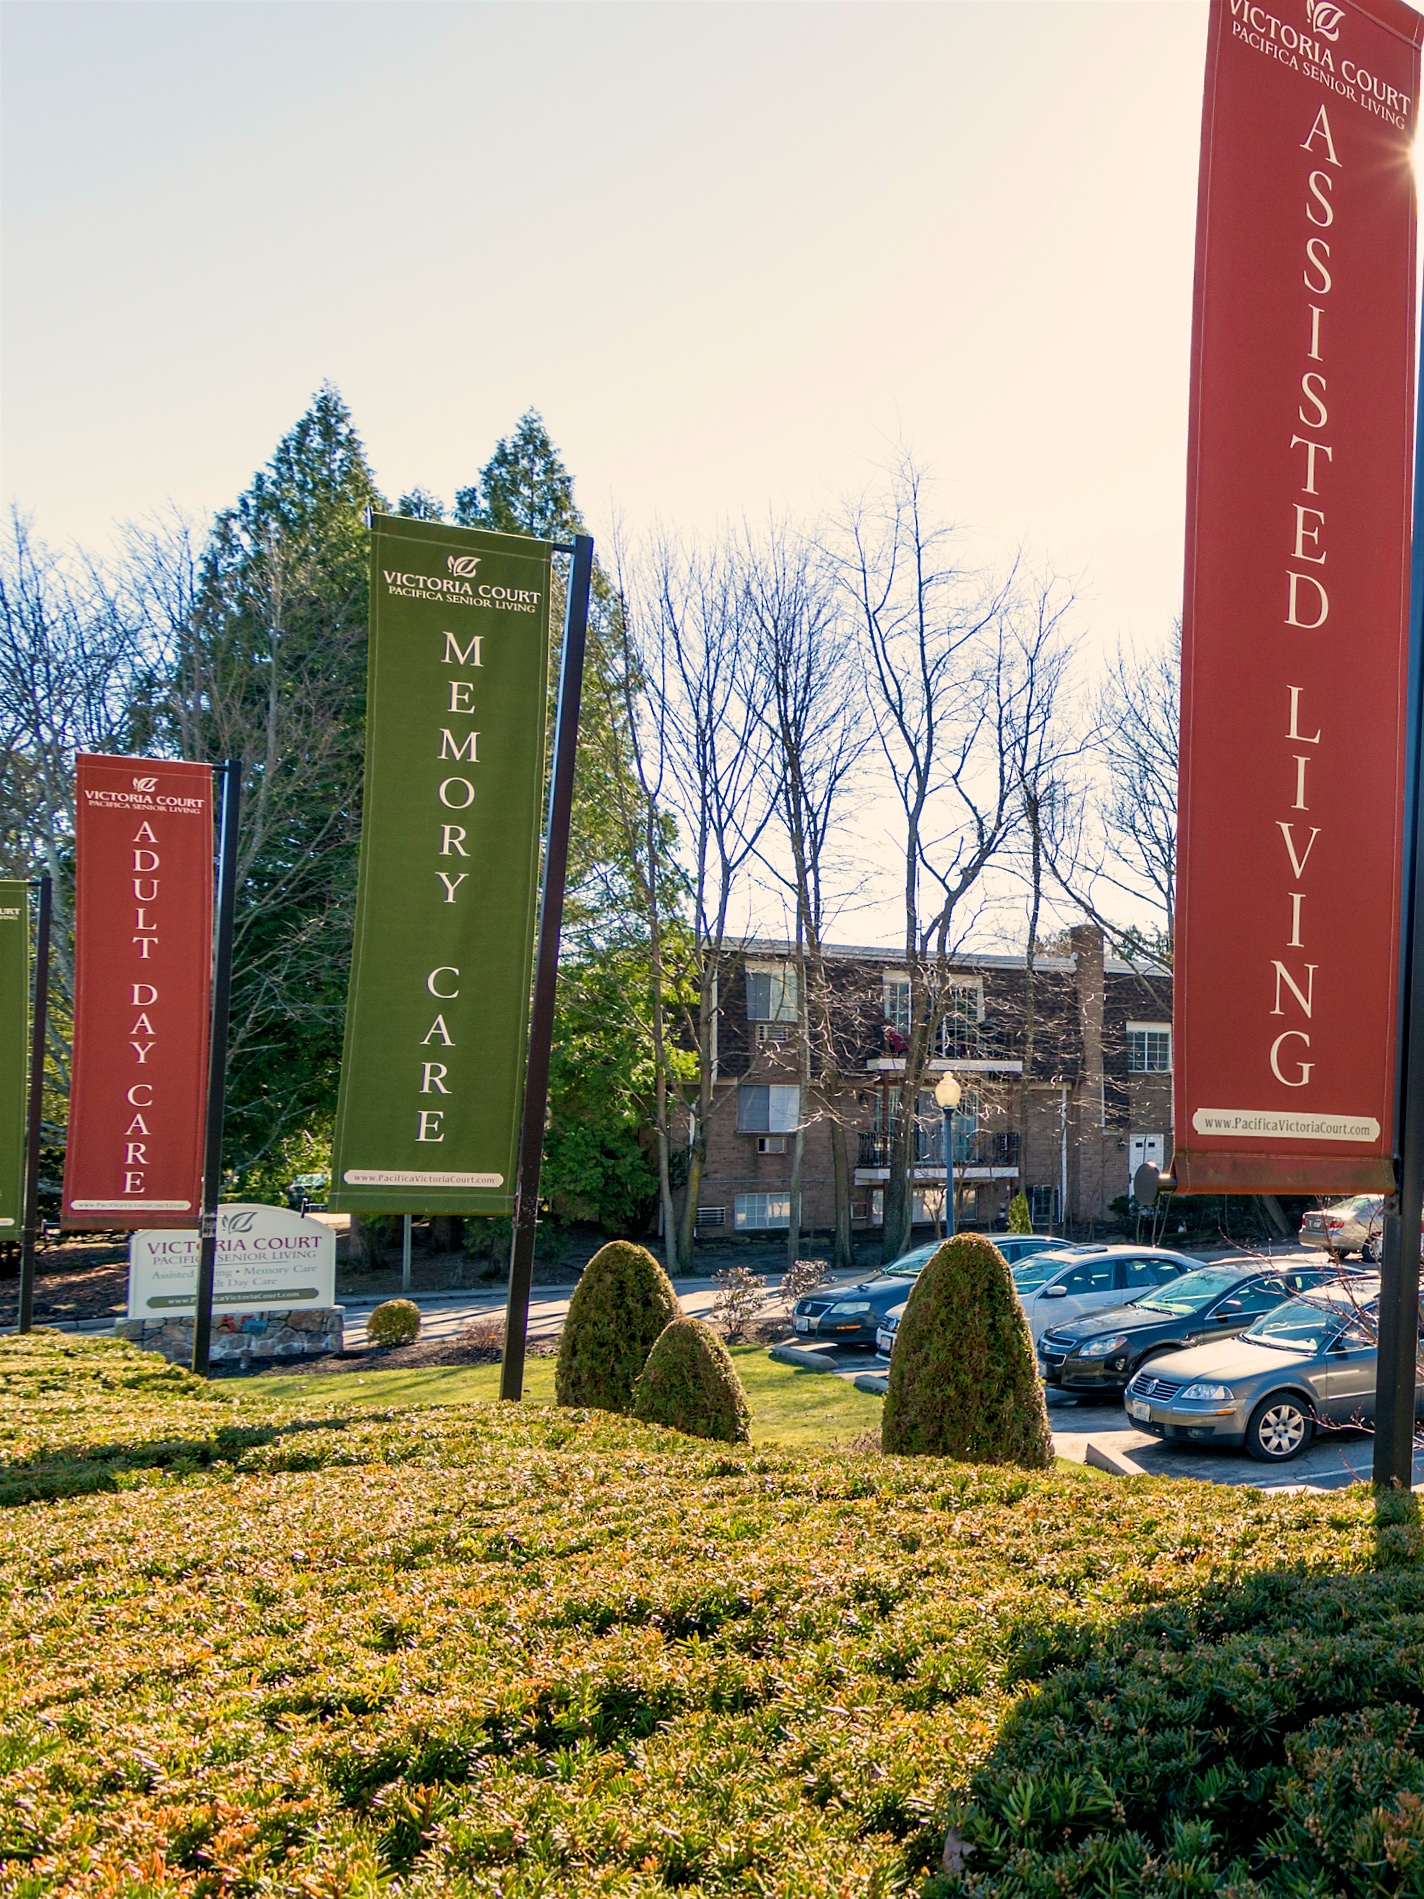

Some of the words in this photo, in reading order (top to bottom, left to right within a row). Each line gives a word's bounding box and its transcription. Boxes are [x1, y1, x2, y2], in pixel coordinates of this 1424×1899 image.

[1230, 0, 1335, 73] VICTORIA
[1341, 60, 1411, 116] COURT
[1232, 20, 1299, 71] PACIFICA
[1302, 61, 1357, 102] SENIOR
[1360, 94, 1405, 130] LIVING
[1284, 103, 1343, 629] ASSISTED
[383, 569, 473, 595] VICTORIA
[478, 585, 541, 604] COURT
[388, 585, 443, 602] PACIFICA
[446, 594, 492, 608] SENIOR
[496, 600, 536, 613] LIVING
[435, 631, 485, 903] MEMORY
[84, 789, 153, 804] VICTORIA
[156, 796, 205, 808] COURT
[88, 799, 131, 809] PACIFICA
[132, 803, 167, 812] SENIOR
[169, 806, 200, 815] LIVING
[132, 820, 160, 959] ADULT
[1269, 684, 1321, 1087] LIVING
[0, 907, 21, 915] URT
[129, 983, 158, 1064] DAY
[414, 966, 460, 1143] CARE
[122, 1083, 153, 1194] CARE
[1204, 1117, 1370, 1136] www.PacificaVictoriaCourt.com
[354, 1173, 495, 1184] www.PacificaVictoriaCourt.com
[147, 1239, 246, 1255] VICTRIA
[253, 1236, 322, 1251] COURT
[217, 1251, 268, 1262] SENIOR
[272, 1250, 316, 1261] LIVING
[152, 1270, 195, 1280] Assisted
[244, 1267, 289, 1275] Memory
[293, 1264, 317, 1273] Care
[228, 1279, 248, 1288] Day
[253, 1278, 277, 1286] Care
